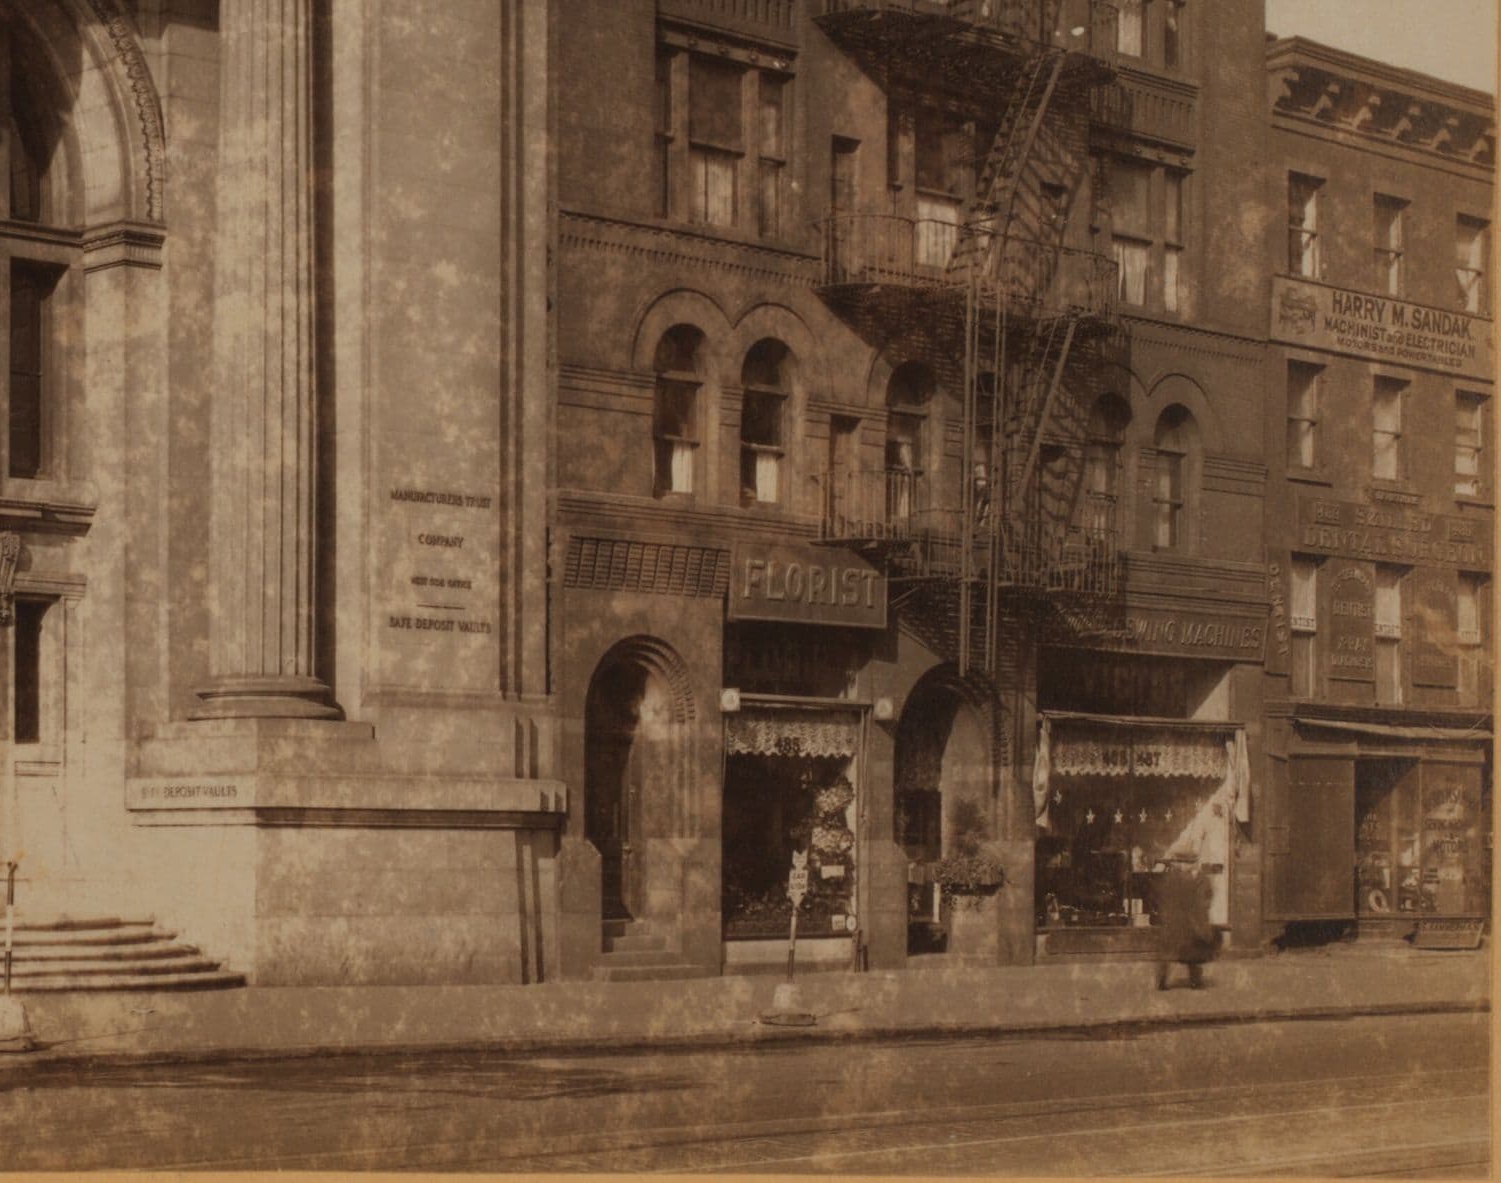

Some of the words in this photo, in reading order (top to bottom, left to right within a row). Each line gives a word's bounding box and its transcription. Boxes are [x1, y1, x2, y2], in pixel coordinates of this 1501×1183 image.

[1331, 291, 1386, 323] HARRY
[1392, 303, 1408, 328] M.
[1324, 316, 1387, 341] MACHINIST
[1405, 332, 1477, 359] ELECTRICIAN
[465, 496, 492, 509] TRUST
[418, 533, 464, 548] COMPANY
[743, 559, 880, 608] FLORIST
[389, 616, 412, 629] SAFE
[415, 618, 455, 632] DEPOSIT
[458, 620, 492, 634] VAULTS
